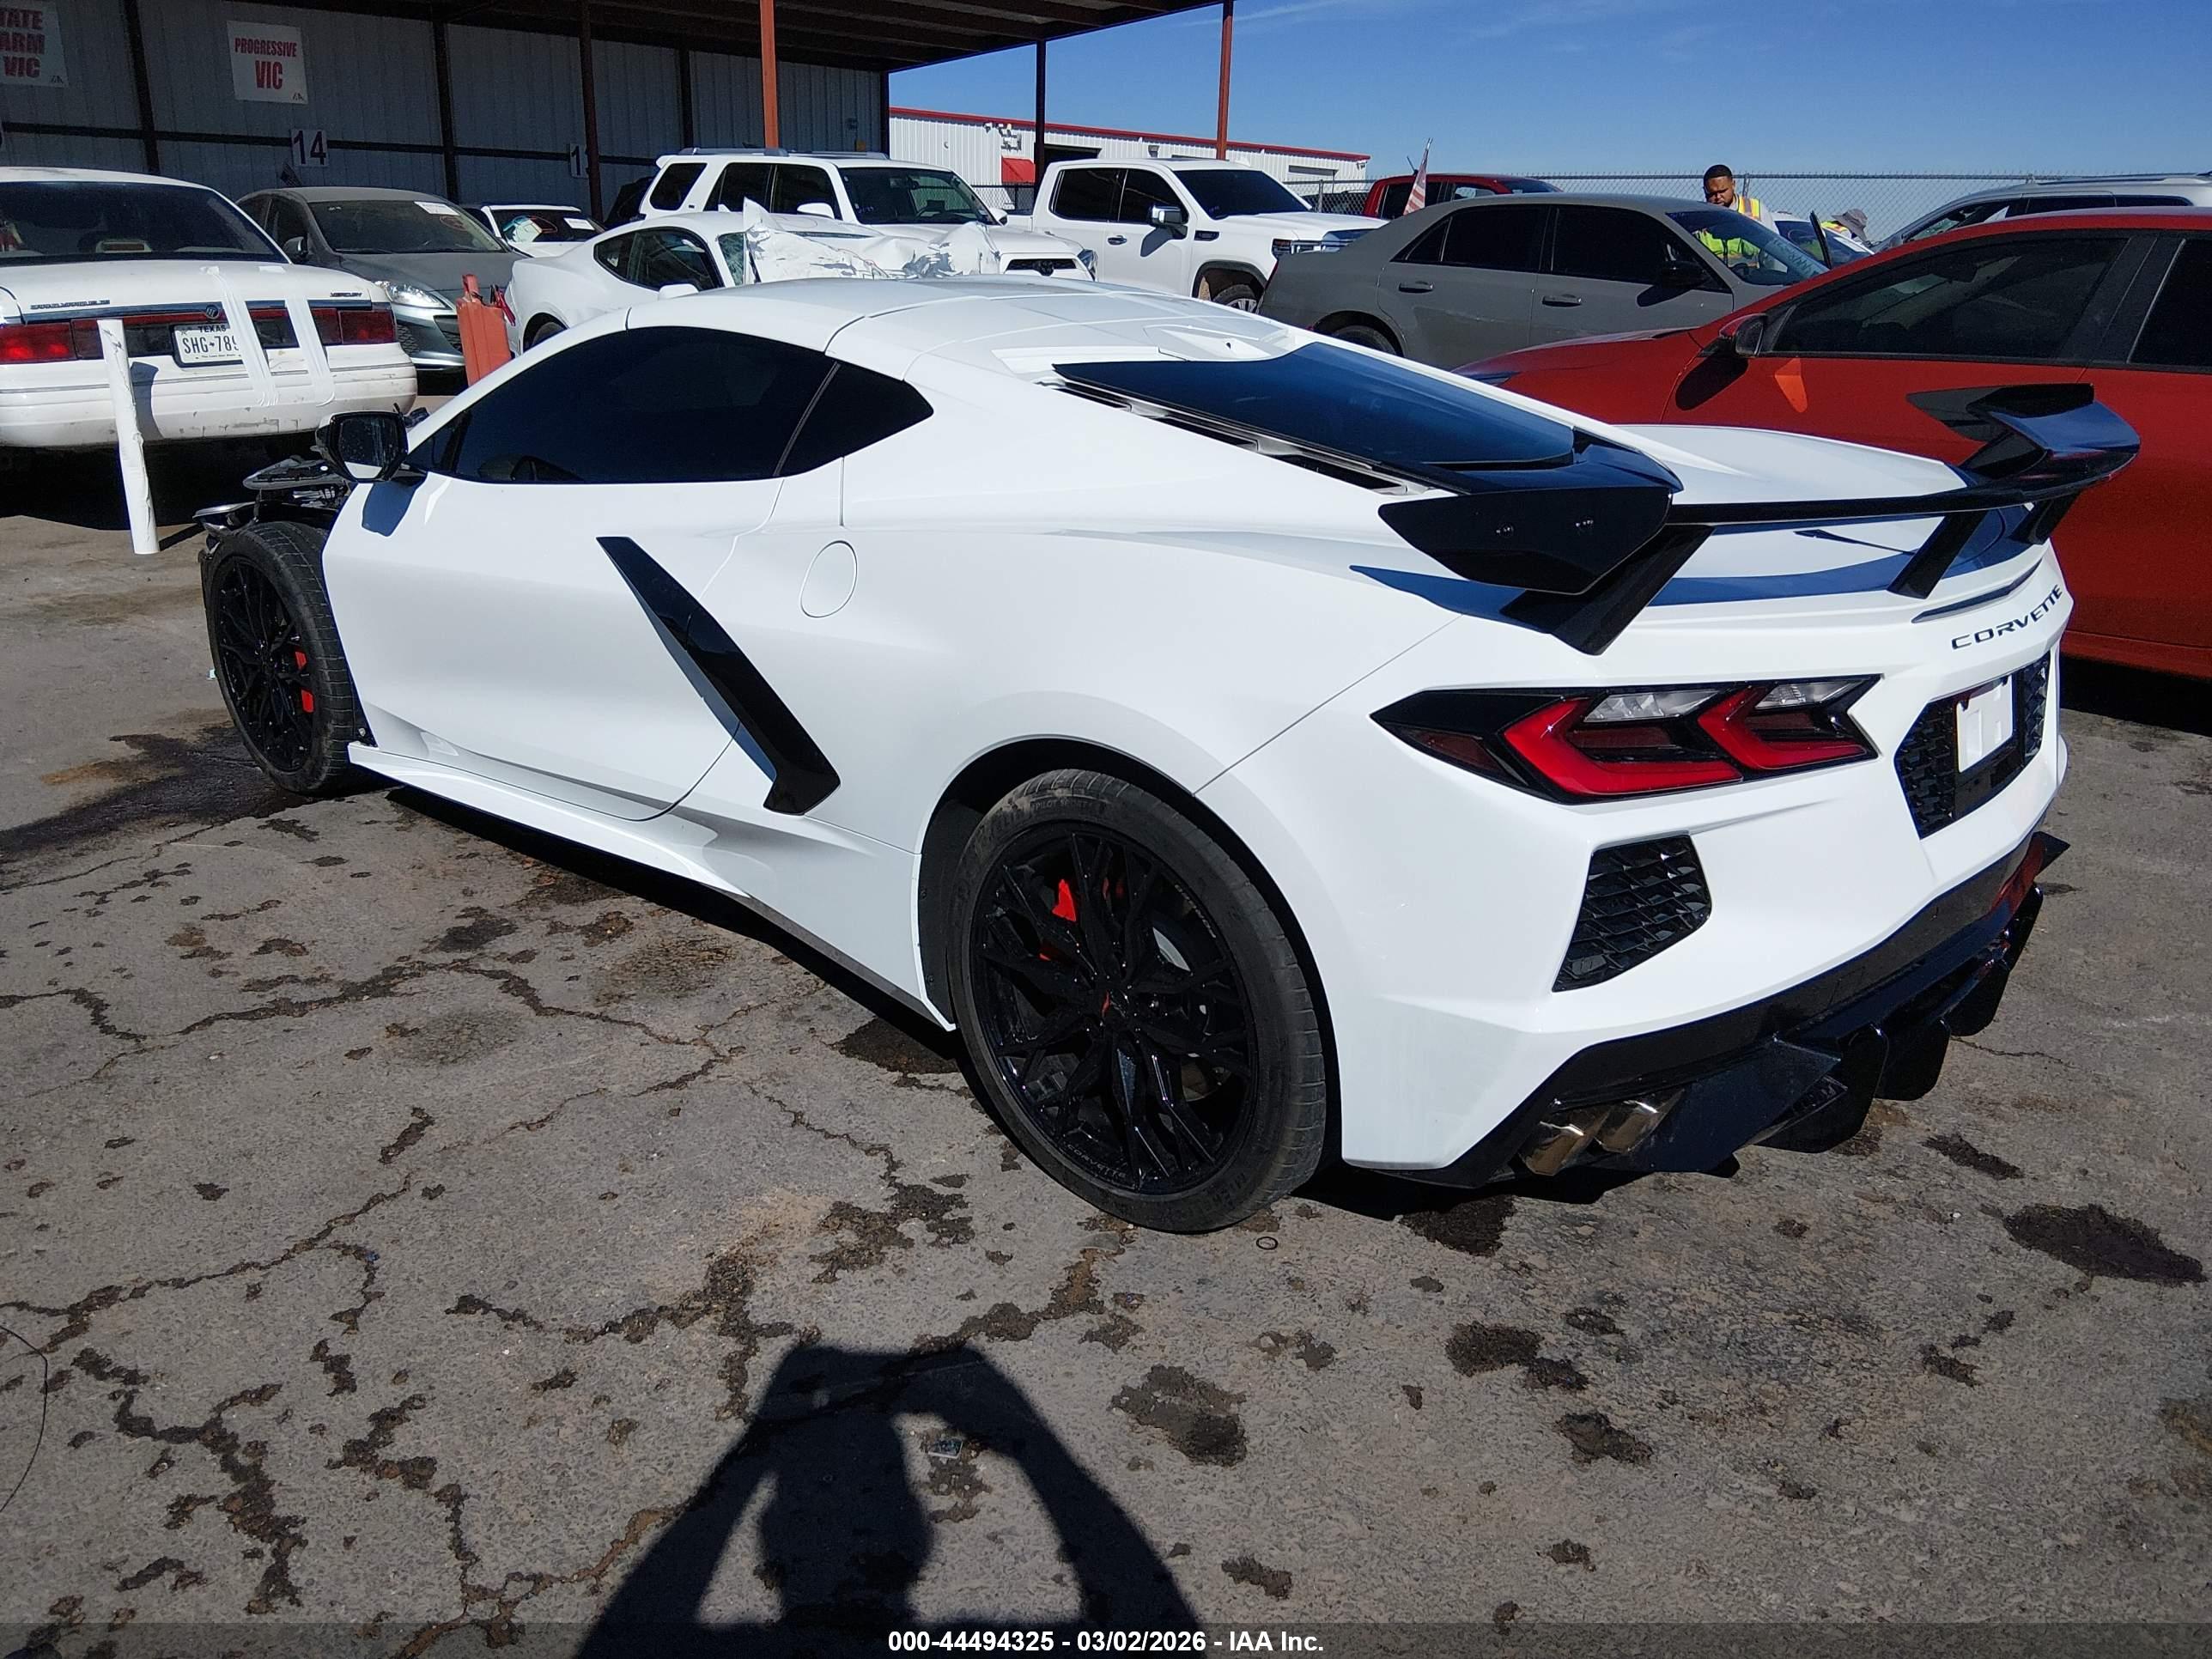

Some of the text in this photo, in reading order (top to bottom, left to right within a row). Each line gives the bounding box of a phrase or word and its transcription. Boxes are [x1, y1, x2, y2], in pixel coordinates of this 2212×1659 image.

[234, 38, 297, 58] PROGRESSIVE
[3, 56, 40, 78] VIC
[255, 60, 283, 90] VIC
[293, 130, 326, 166] 14
[198, 325, 226, 333] TEXAS
[1951, 584, 2063, 650] CORVETTE
